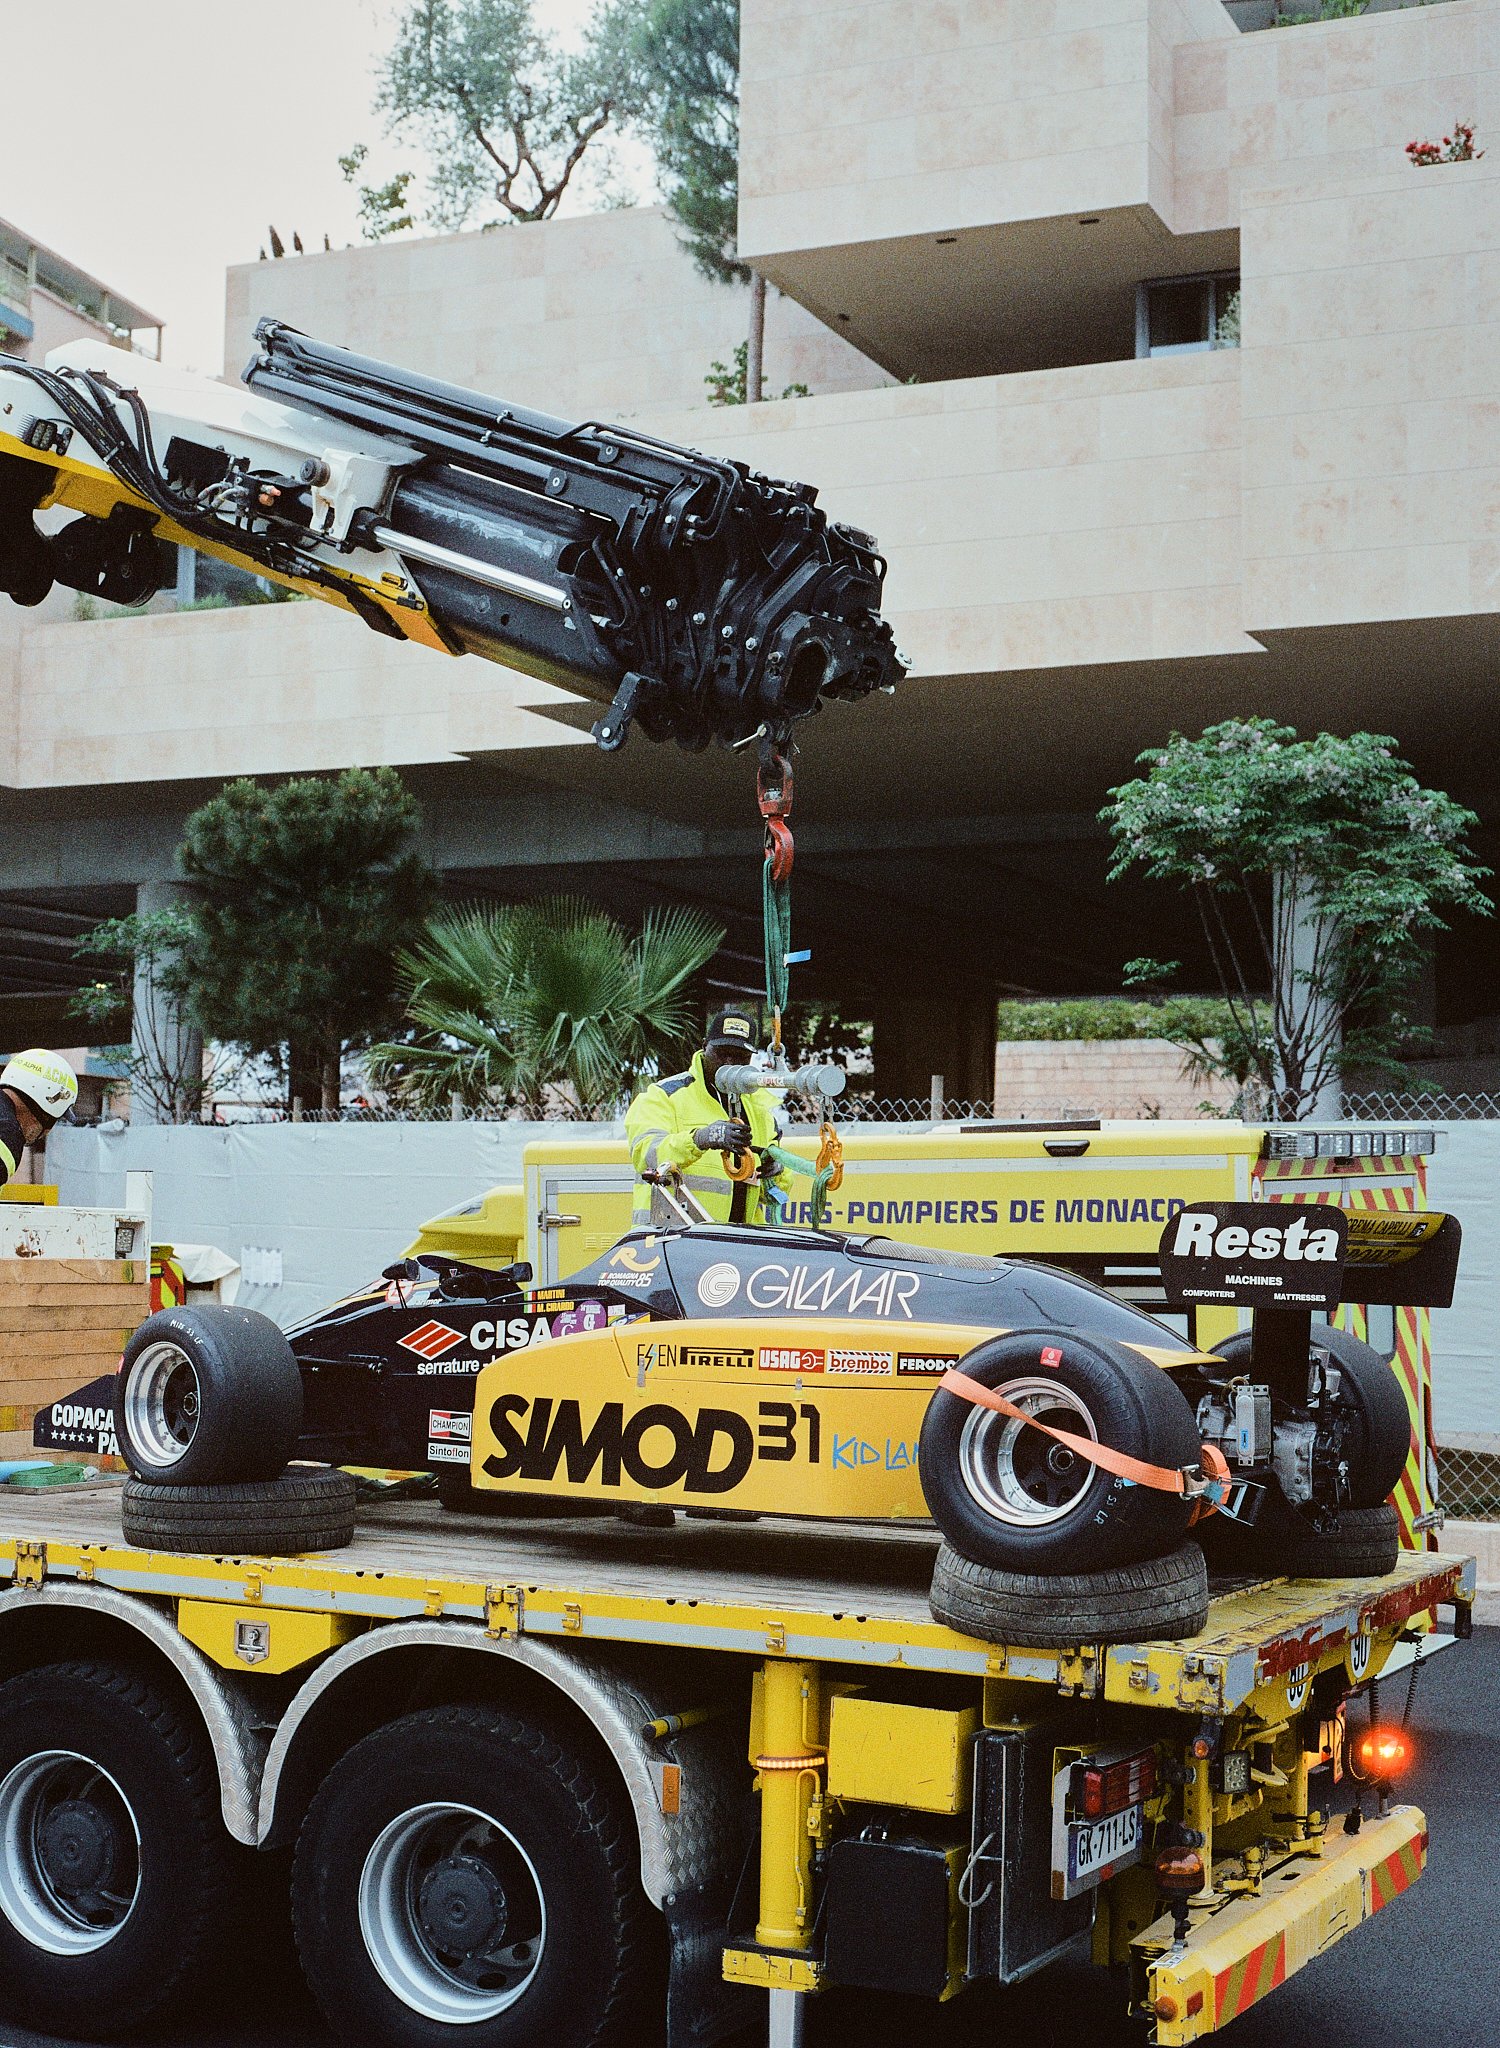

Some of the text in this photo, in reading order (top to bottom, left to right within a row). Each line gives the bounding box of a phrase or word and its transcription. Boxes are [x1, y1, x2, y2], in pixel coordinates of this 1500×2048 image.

[1009, 1199, 1045, 1223] DE
[1173, 1212, 1340, 1262] Resta
[1225, 1274, 1283, 1286] MACHINES
[746, 1264, 921, 1319] GILMAR
[1182, 1289, 1236, 1298] COMFORTERS
[1273, 1292, 1327, 1302] MATTRESSES
[469, 1317, 553, 1350] CISA
[417, 1357, 480, 1376] serrature
[679, 1346, 755, 1368] PIRELLI
[759, 1349, 801, 1369] USAG
[830, 1355, 889, 1370] brembo
[432, 1419, 469, 1431] CHAMPION
[757, 1401, 821, 1464] 31
[429, 1445, 470, 1458] Sintoflon
[481, 1393, 754, 1494] SIMOD
